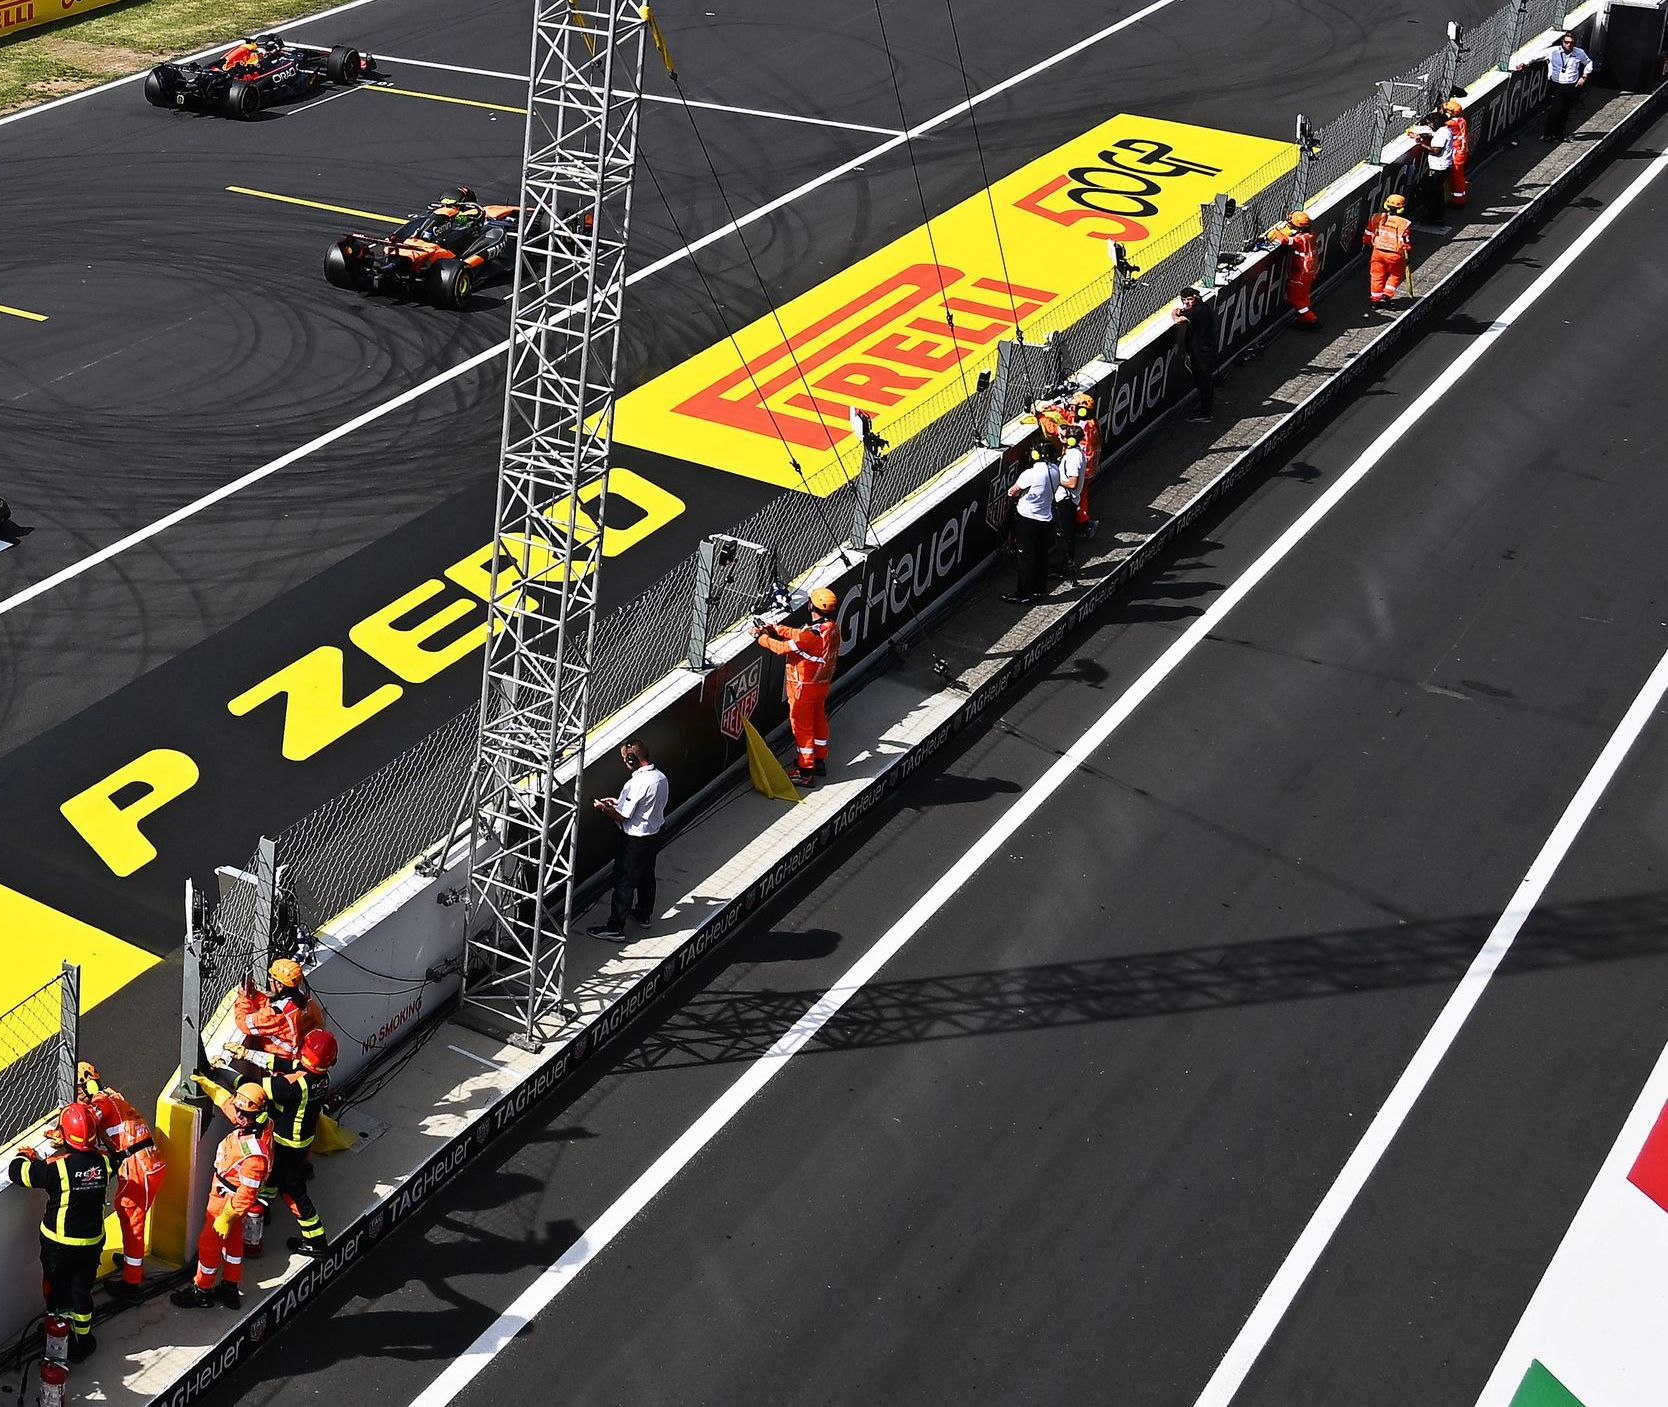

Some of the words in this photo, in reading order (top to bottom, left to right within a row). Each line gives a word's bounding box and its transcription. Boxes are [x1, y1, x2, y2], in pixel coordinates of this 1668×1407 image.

[1487, 58, 1549, 141] TAGHeu
[671, 262, 1059, 452] PIRELLI
[1096, 344, 1176, 444] Heuer
[836, 497, 978, 658] GHeuer
[59, 748, 200, 878] P
[227, 466, 686, 761] ZERO
[728, 659, 761, 699] TAG
[361, 1031, 377, 1056] NO
[378, 996, 423, 1038] SMOKING
[160, 1338, 245, 1407] AGHeuer
